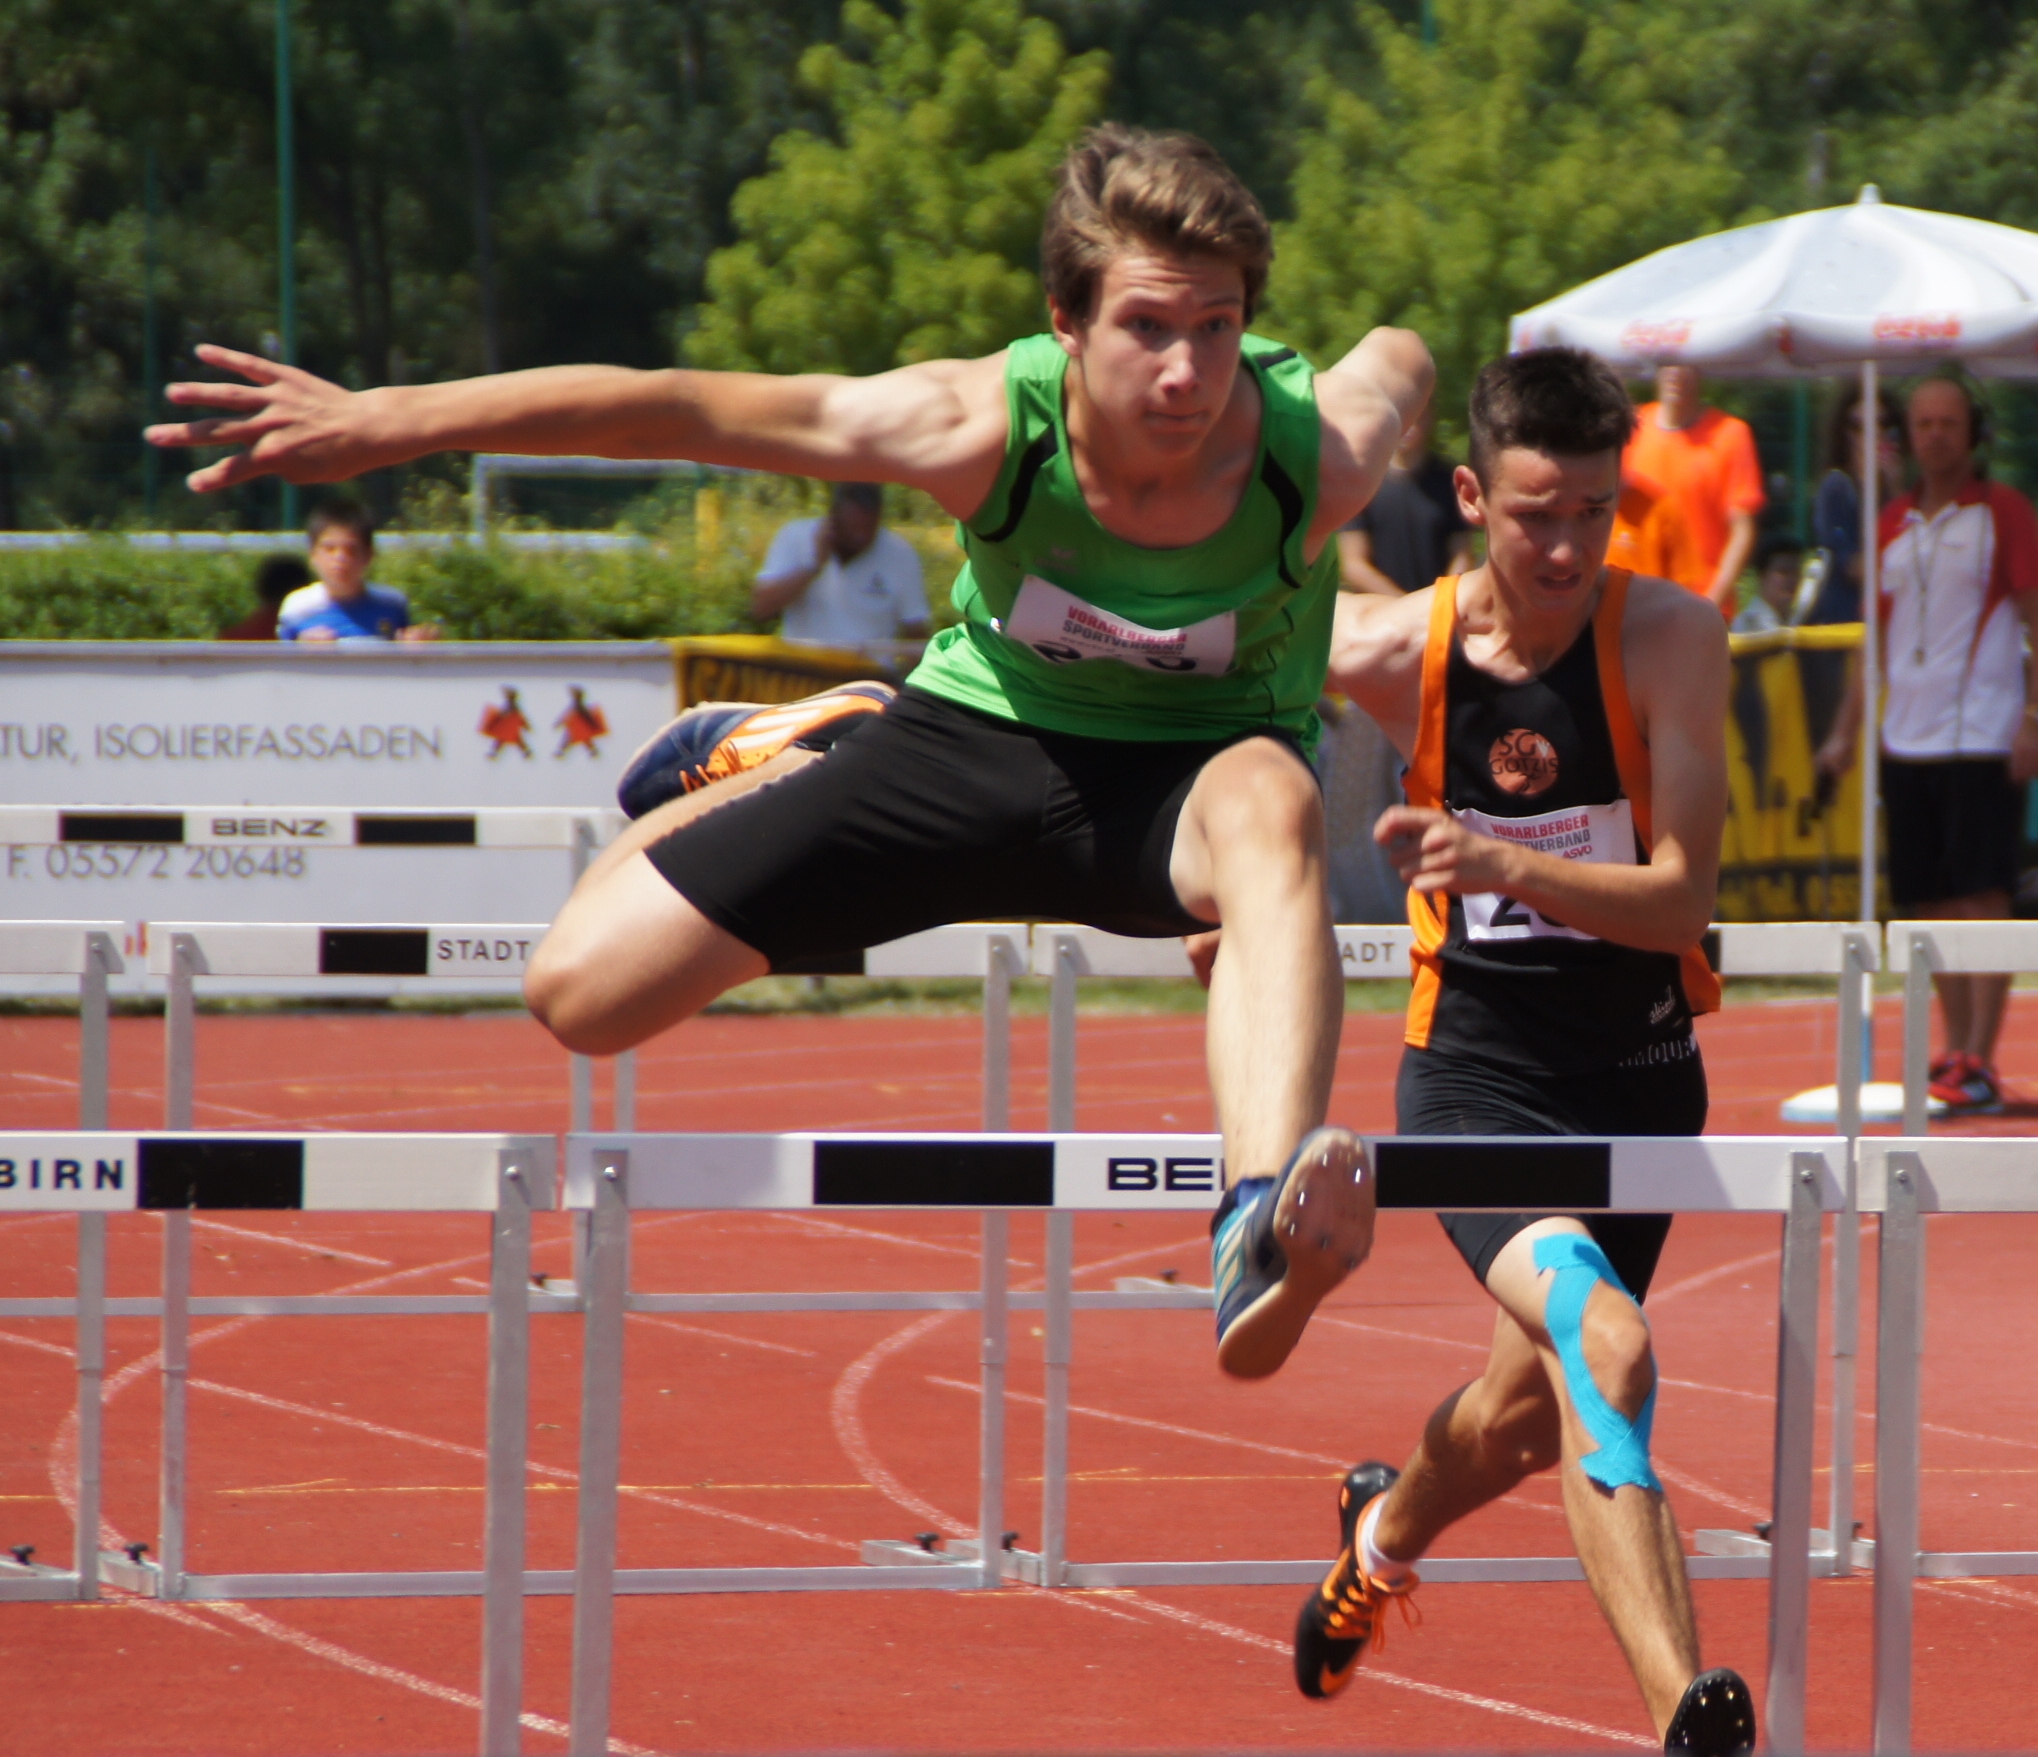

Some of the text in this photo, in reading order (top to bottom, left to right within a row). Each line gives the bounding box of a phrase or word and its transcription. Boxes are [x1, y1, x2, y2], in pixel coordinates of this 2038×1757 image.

[0, 722, 442, 765] TUR, ISOLIERFASSADEN
[211, 818, 328, 838] BENZ
[1490, 814, 1589, 839] VORARLBERGER
[45, 844, 170, 879] 05572
[186, 844, 306, 880] 20648
[437, 938, 530, 961] STADT
[0, 1158, 124, 1190] BIRN
[1108, 1157, 1226, 1191] BE
